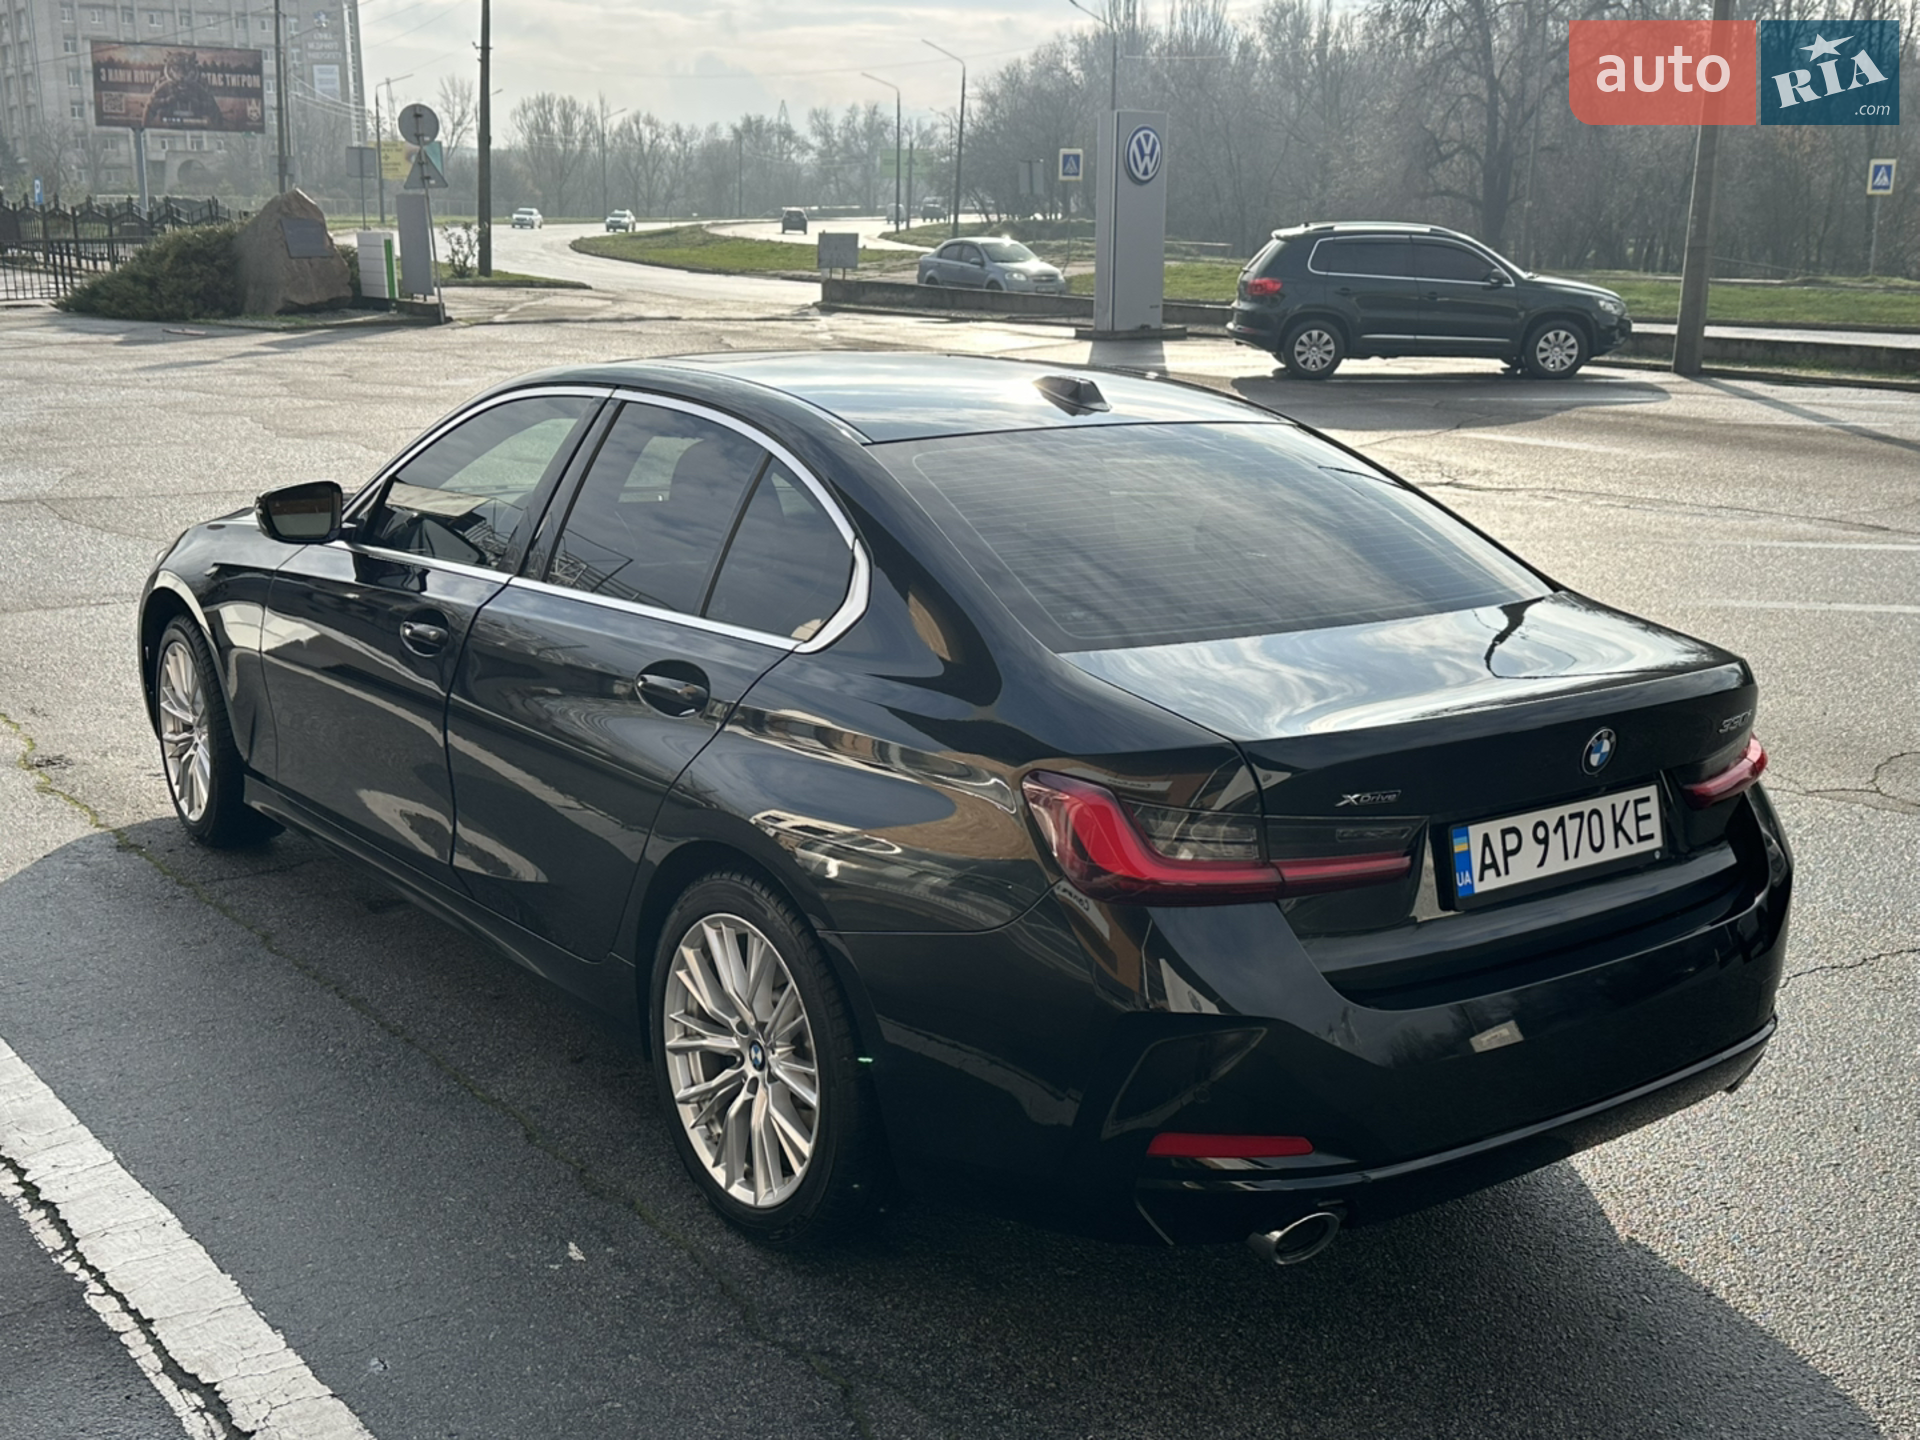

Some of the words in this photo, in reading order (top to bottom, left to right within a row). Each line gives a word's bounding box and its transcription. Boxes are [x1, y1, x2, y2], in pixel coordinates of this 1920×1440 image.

[1478, 825, 1523, 883] AP
[1531, 807, 1606, 869] 9170
[1610, 795, 1655, 849] KE
[1456, 870, 1472, 887] UA
